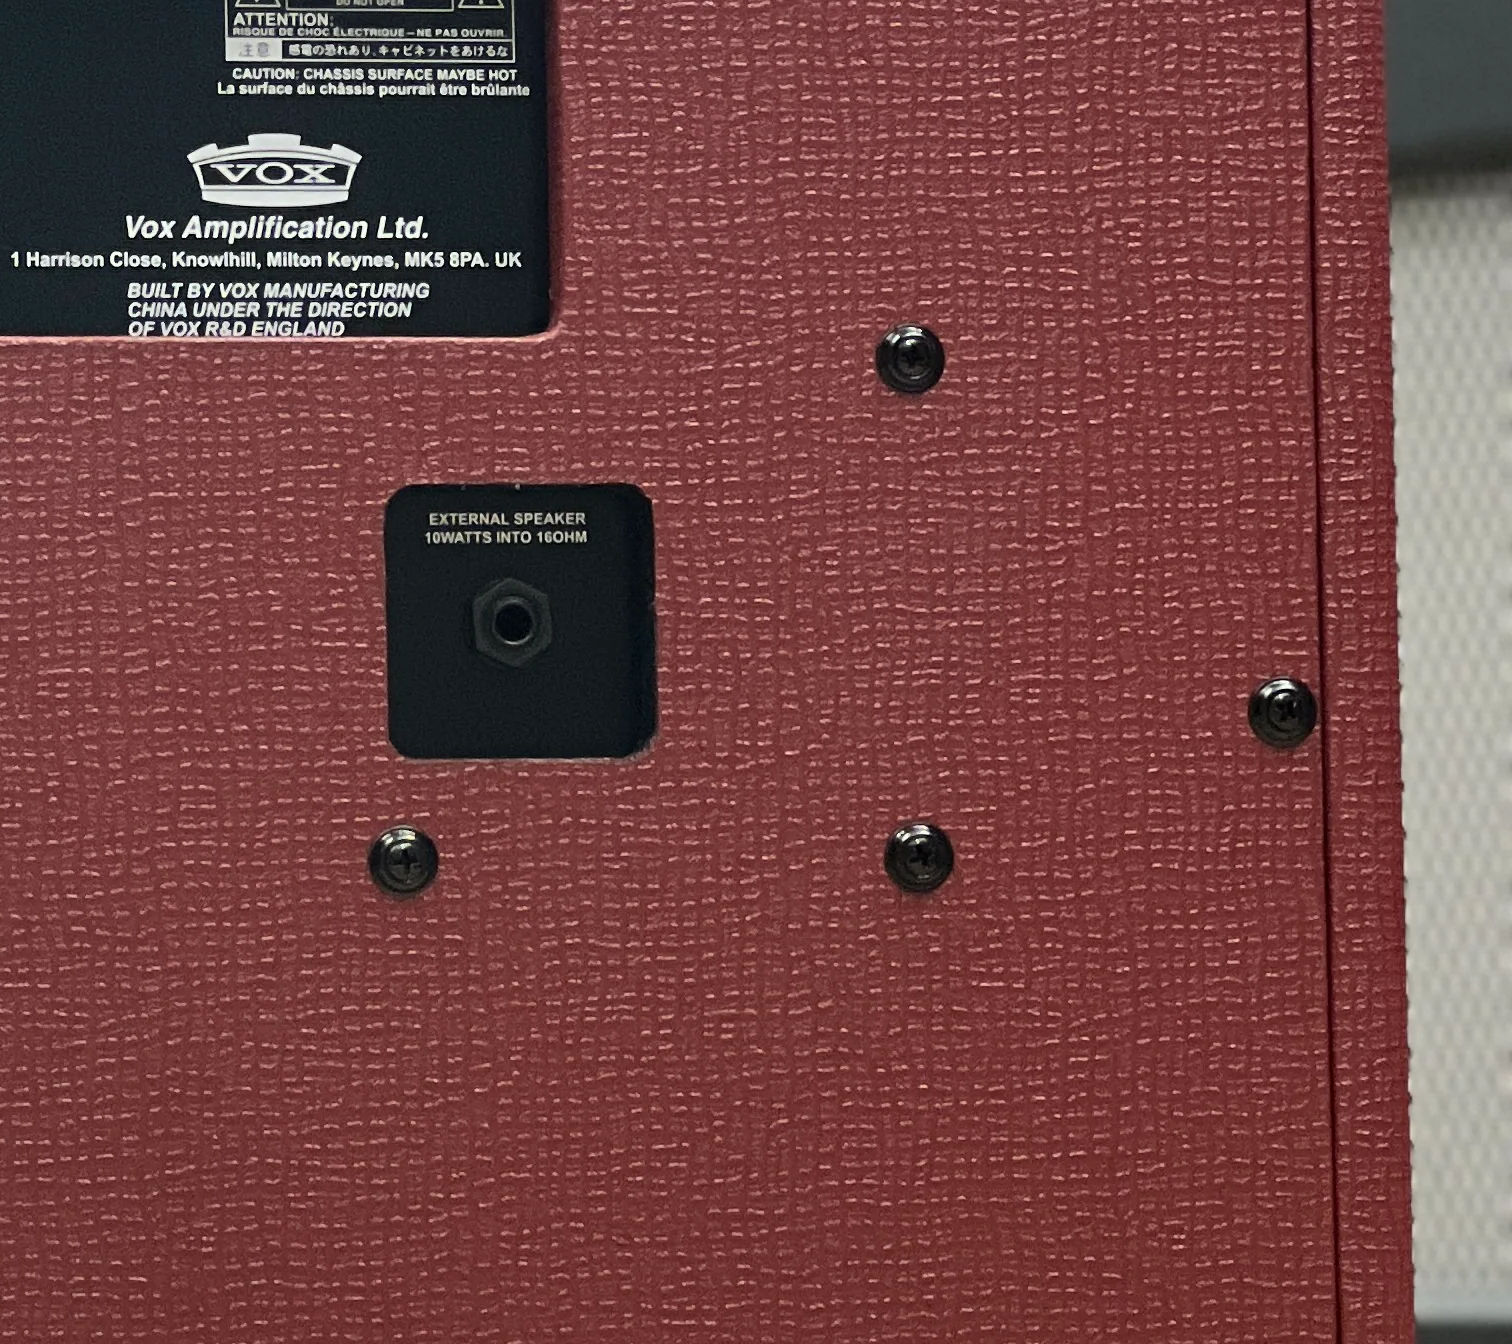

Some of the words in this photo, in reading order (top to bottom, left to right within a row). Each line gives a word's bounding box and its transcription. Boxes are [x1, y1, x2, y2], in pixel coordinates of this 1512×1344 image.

[233, 11, 335, 27] ATTENTION:
[232, 27, 275, 36] RISQUE
[278, 27, 294, 36] DE
[297, 27, 330, 36] CHOC
[416, 28, 433, 37] NE
[435, 28, 459, 38] PAS
[232, 68, 300, 80] CAUTION:
[303, 68, 365, 80] CHASSIS
[368, 68, 434, 80] SURFACE
[437, 68, 486, 81] MAYBE
[488, 69, 518, 81] HOT
[217, 82, 235, 95] La
[238, 82, 293, 95] surface
[296, 82, 316, 95] du
[378, 83, 436, 98] pourrait
[209, 162, 336, 184] VOX
[125, 215, 176, 239] Vox
[182, 215, 368, 244] Amplification
[377, 215, 429, 239] Ltd.
[10, 251, 20, 267] 1
[26, 251, 105, 268] Harrison
[109, 251, 167, 270] Close,
[172, 251, 262, 270] Knowlhill,
[266, 251, 322, 268] Milton
[327, 251, 400, 272] Keynes,
[404, 251, 445, 268] MK5
[449, 251, 490, 268] 8PA.
[494, 251, 523, 268] UK
[127, 283, 184, 298] BUILT
[187, 283, 215, 298] BY
[219, 283, 260, 298] VOX
[263, 283, 430, 299] MANUFACTURING
[128, 302, 187, 317] CHINA
[192, 302, 261, 317] UNDER
[266, 302, 303, 317] THE
[308, 302, 412, 318] DIRECTION
[128, 321, 155, 337] OF
[161, 321, 201, 337] VOX
[204, 321, 247, 337] R&D
[251, 321, 345, 337] ENGLAND
[429, 513, 509, 525] EXTERNAL
[513, 513, 586, 525] SPEAKER
[425, 531, 492, 544] 10WATTS
[496, 531, 532, 543] INTO
